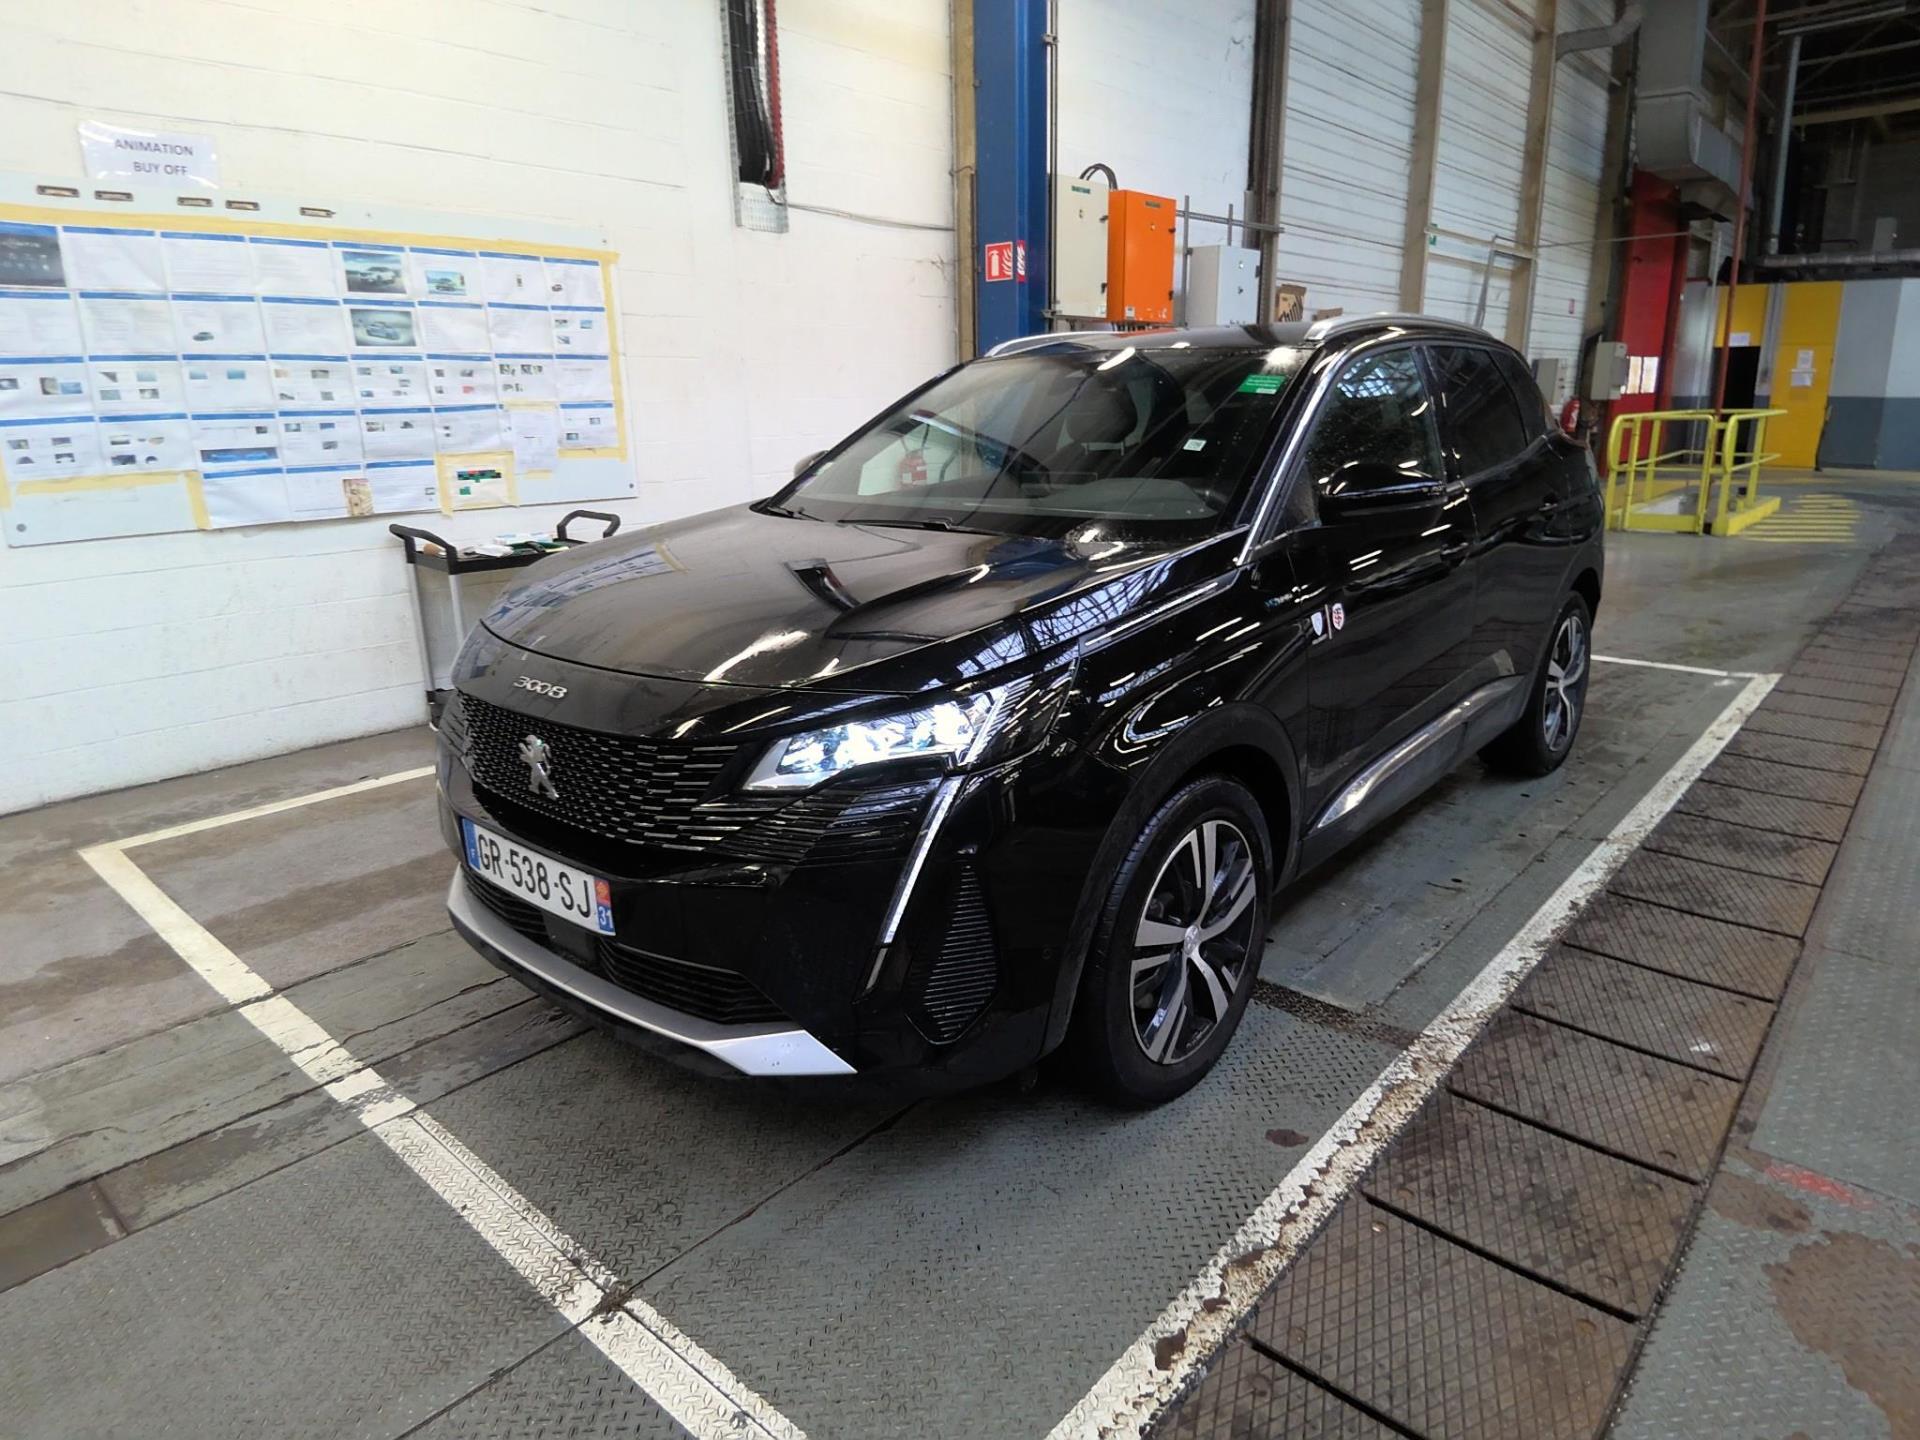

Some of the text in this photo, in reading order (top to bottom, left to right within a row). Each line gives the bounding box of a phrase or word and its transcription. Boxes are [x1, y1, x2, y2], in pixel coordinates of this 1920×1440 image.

[114, 138, 194, 156] ANIMATION
[133, 160, 188, 176] BUY OFF
[513, 675, 568, 699] 3008
[478, 834, 591, 919] GR-538-SJ
[598, 905, 614, 929] 31
